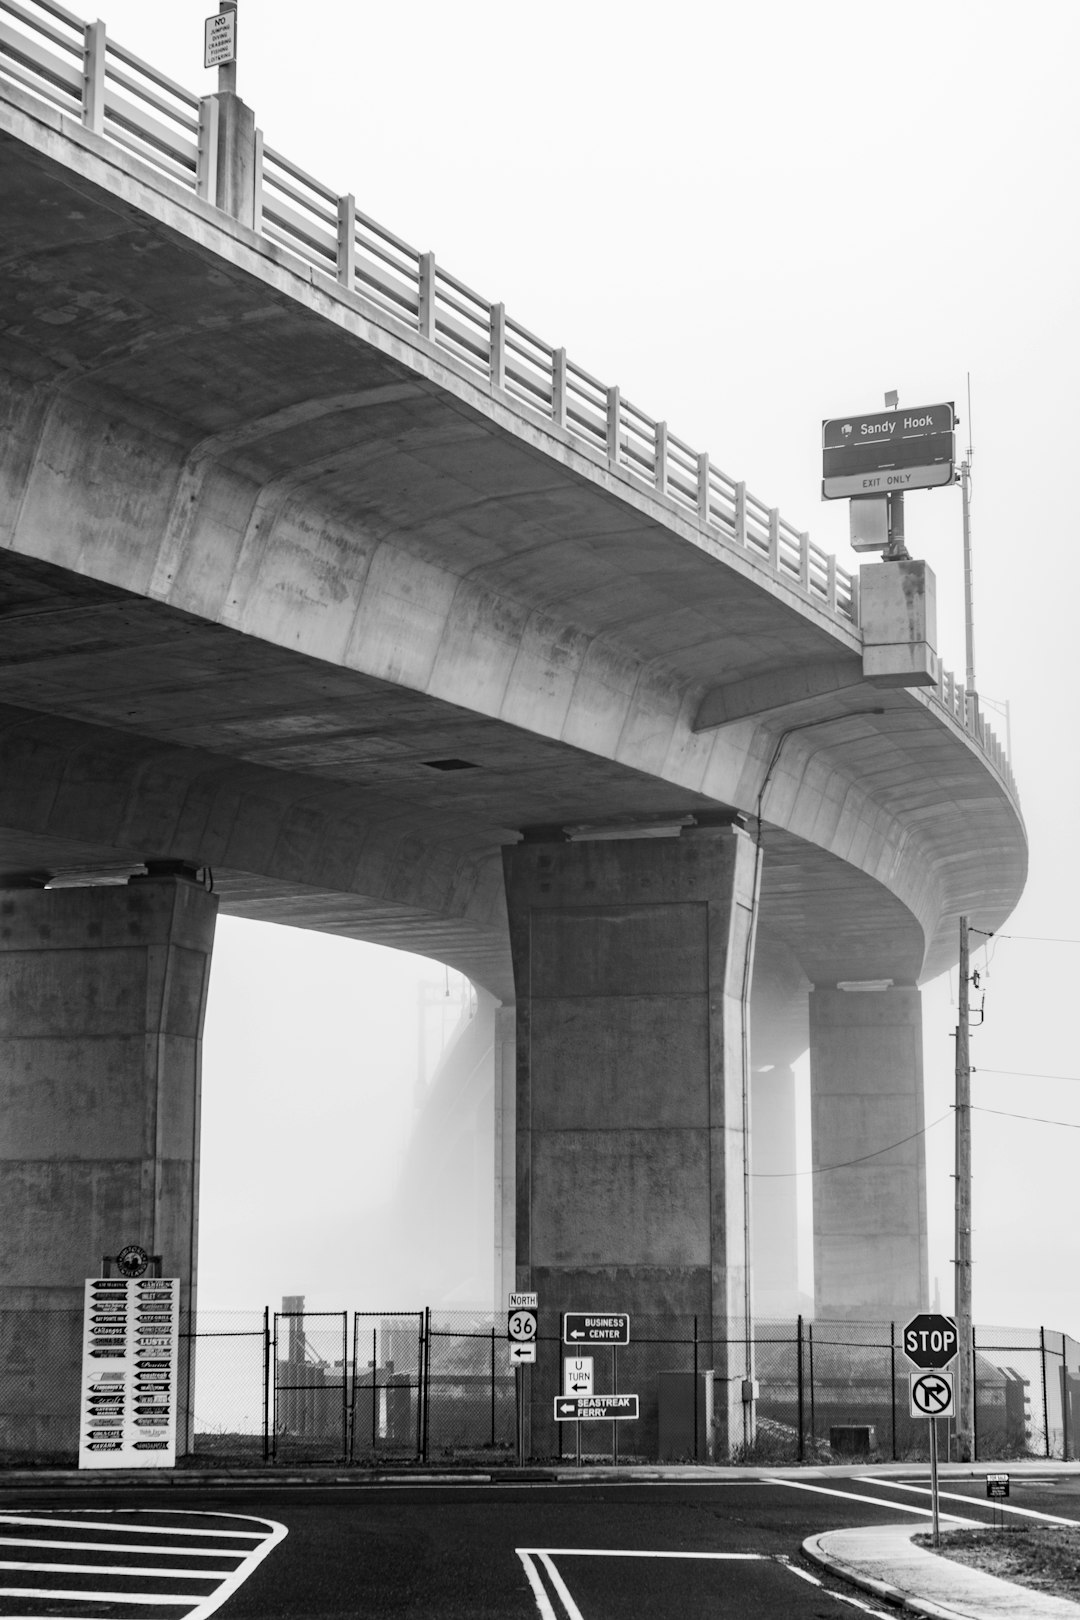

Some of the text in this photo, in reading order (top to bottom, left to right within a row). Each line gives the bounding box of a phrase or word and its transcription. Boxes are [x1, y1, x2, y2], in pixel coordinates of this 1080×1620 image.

[214, 17, 226, 26] NO
[210, 24, 230, 35] JUMPING
[212, 32, 228, 41] DIVING
[208, 38, 231, 50] CRABBING
[210, 45, 228, 56] FISHING
[208, 52, 230, 64] LOITERING
[860, 415, 933, 435] Sandy Hook
[862, 474, 911, 488] EXIT ONLY
[510, 1296, 536, 1305] NORTH
[513, 1318, 532, 1334] 36
[585, 1318, 624, 1327] BUSINESS
[589, 1330, 620, 1338] CENTER
[907, 1330, 955, 1352] STOP
[575, 1361, 582, 1370] U
[578, 1398, 630, 1407] SEASTREAK
[578, 1408, 606, 1416] FERRY
